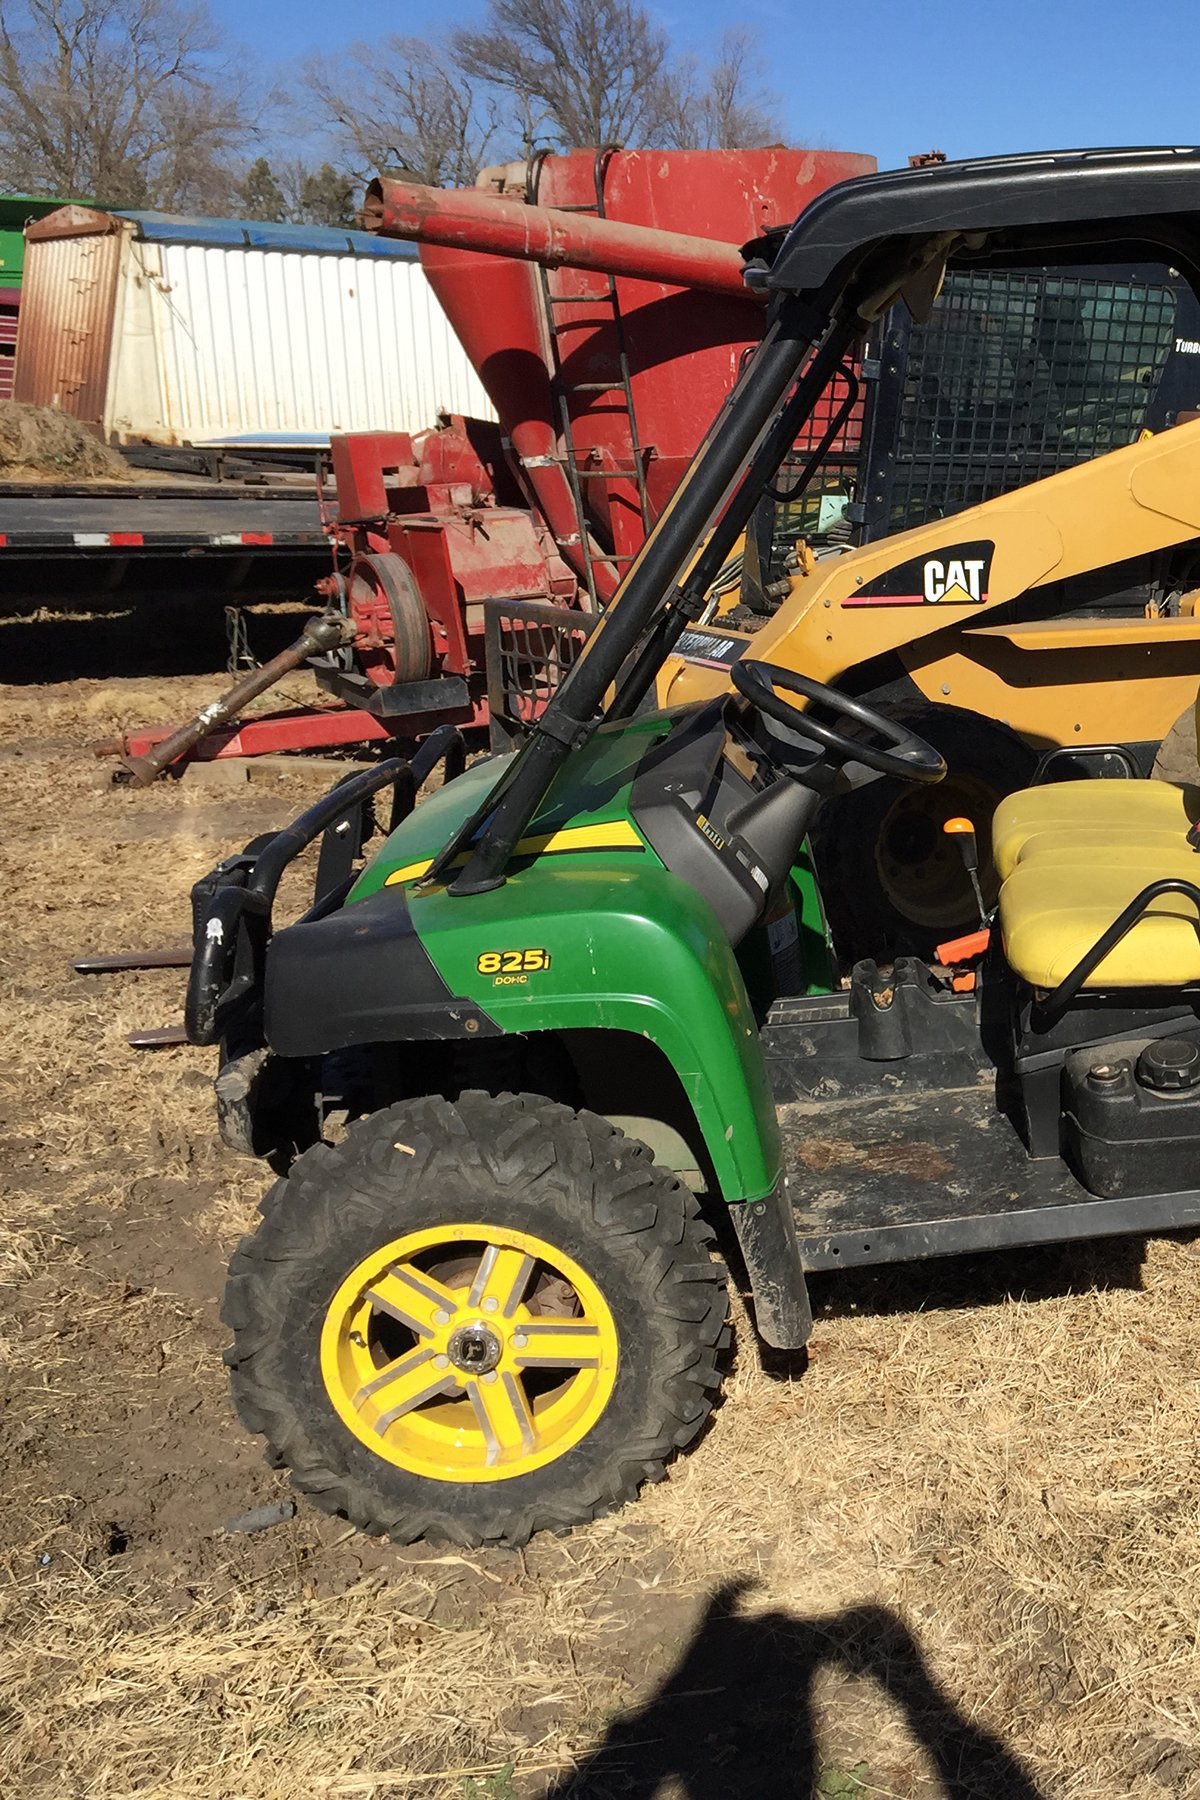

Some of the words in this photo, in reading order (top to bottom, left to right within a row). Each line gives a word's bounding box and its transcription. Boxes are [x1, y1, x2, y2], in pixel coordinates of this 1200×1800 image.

[923, 559, 985, 603] CAT
[477, 949, 550, 974] 825i
[494, 975, 528, 985] DOHC
